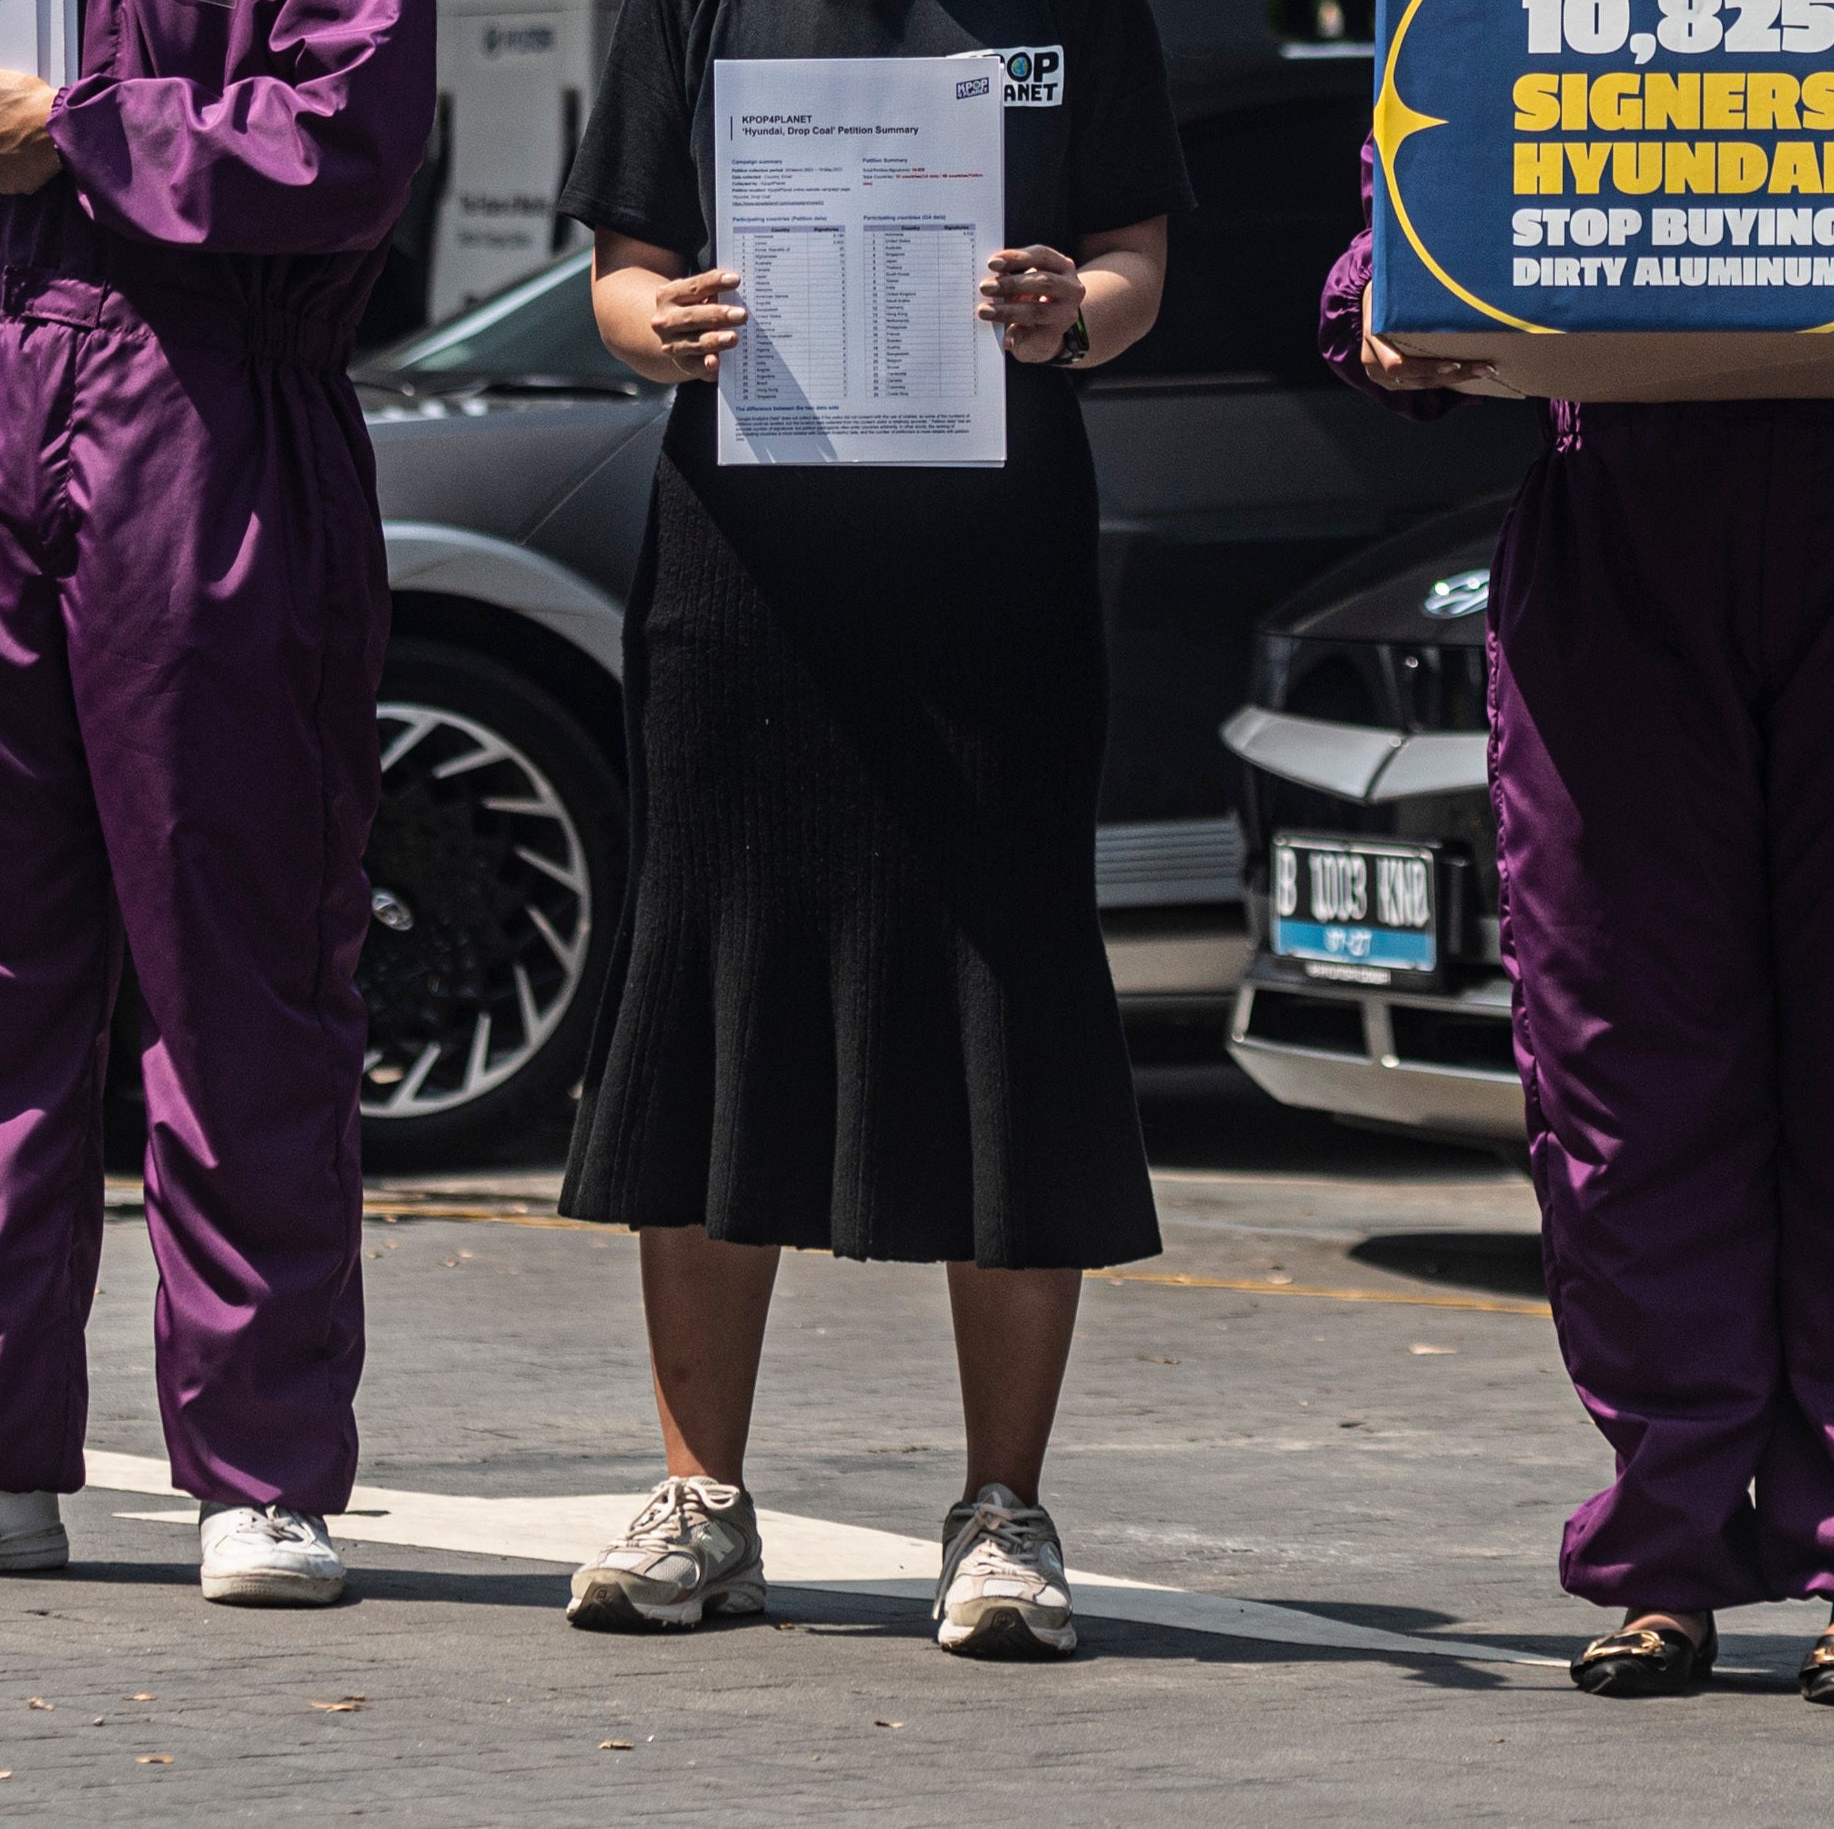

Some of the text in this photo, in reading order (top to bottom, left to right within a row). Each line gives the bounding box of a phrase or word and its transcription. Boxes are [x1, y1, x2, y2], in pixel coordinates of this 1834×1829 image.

[742, 115, 813, 124] KPOP4PLANET
[787, 126, 811, 136] Drop
[838, 125, 873, 135] Petition
[875, 125, 919, 136] Summary
[1512, 207, 1642, 247] STOP
[1513, 257, 1627, 286] DIRTY
[1276, 848, 1297, 917] B
